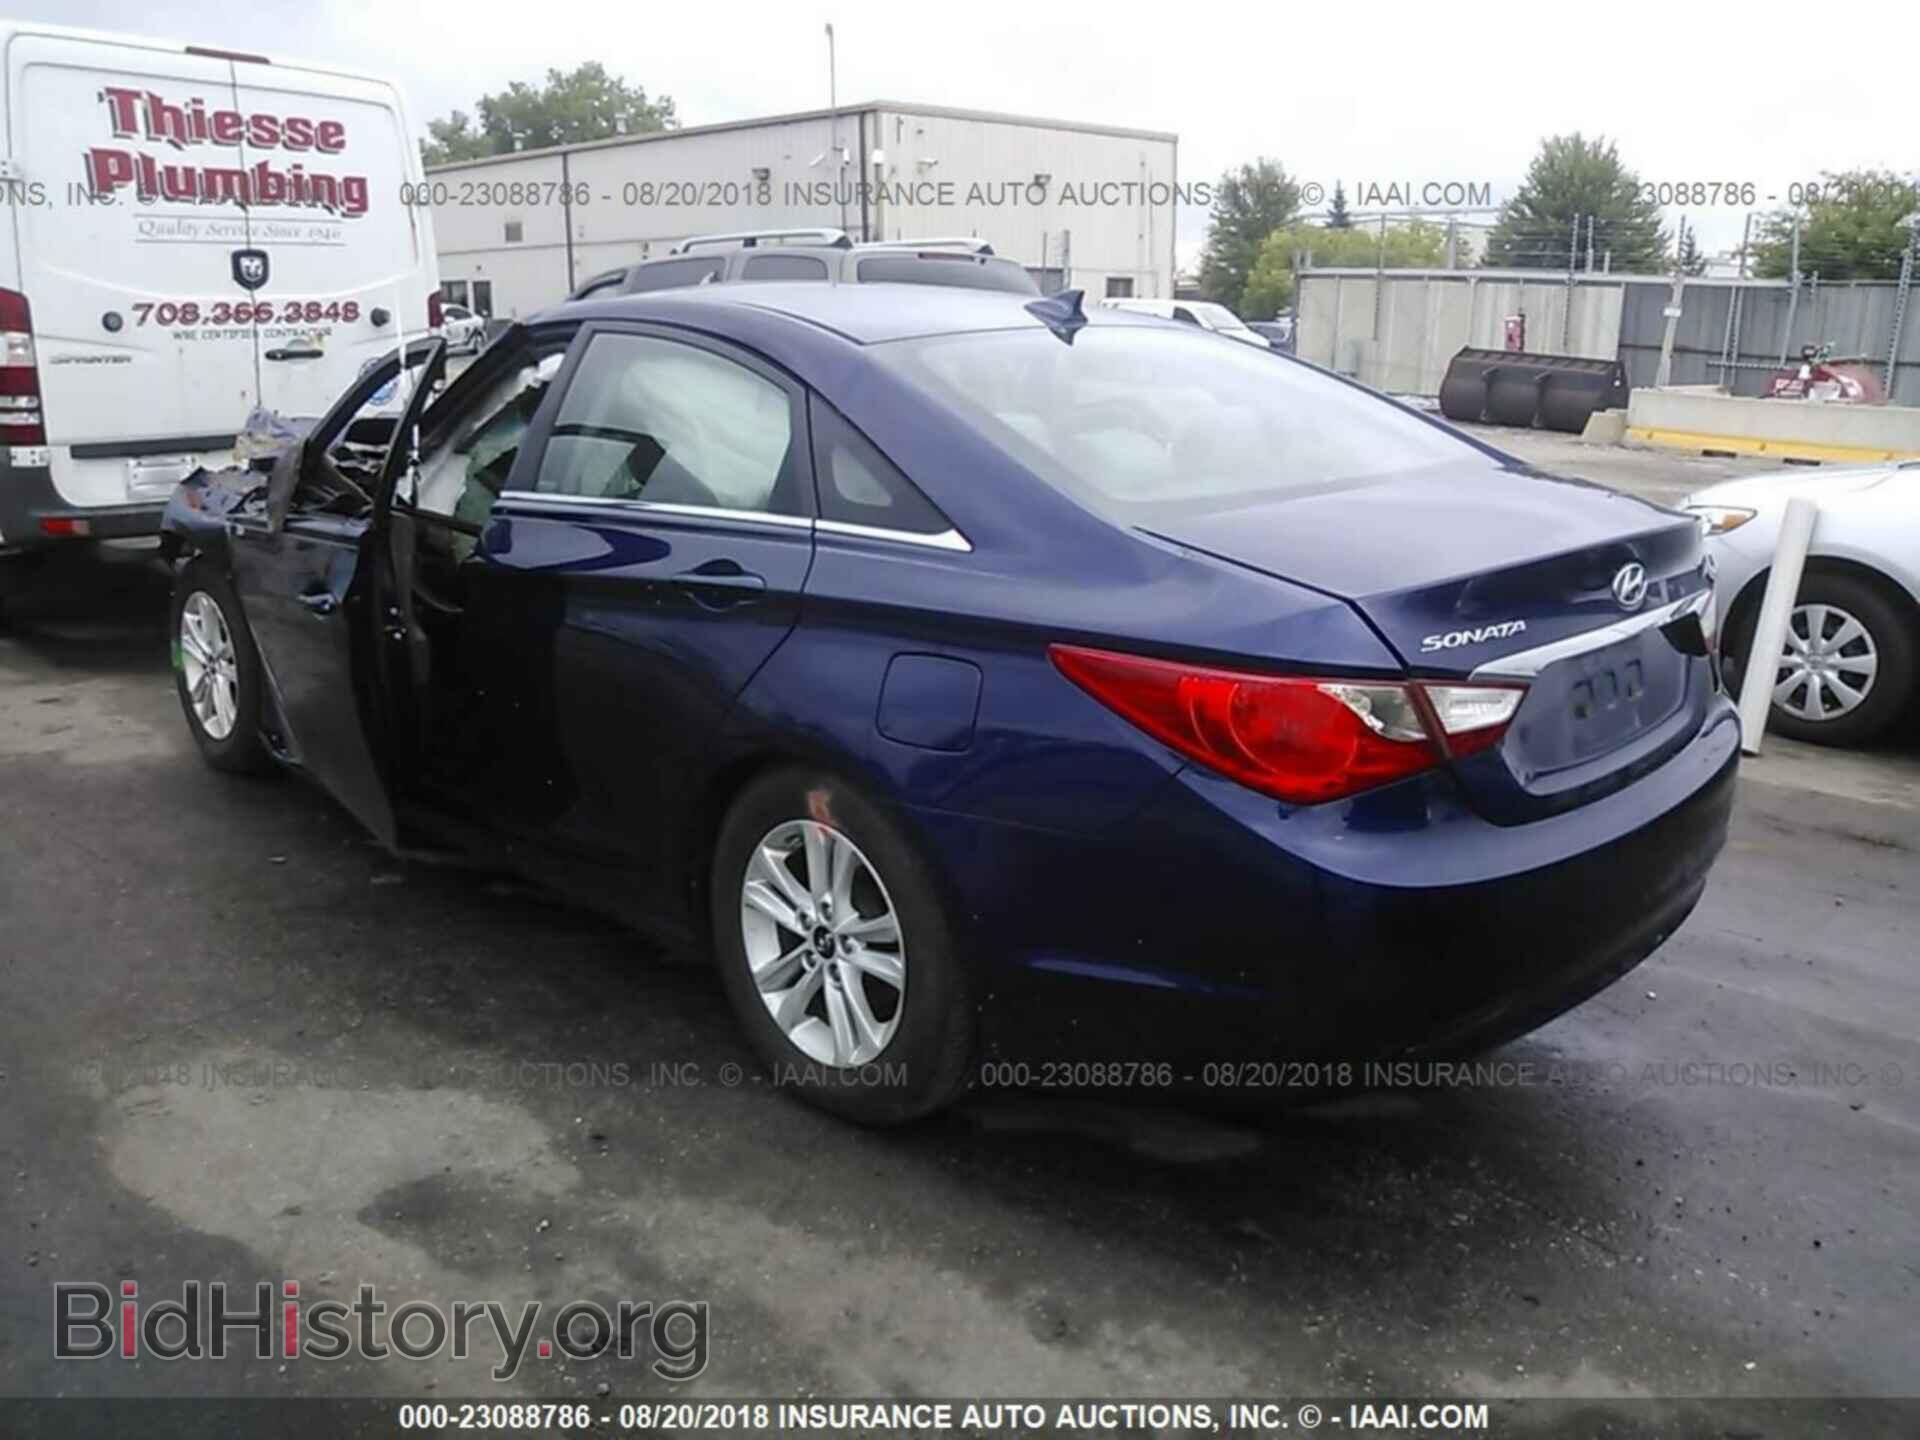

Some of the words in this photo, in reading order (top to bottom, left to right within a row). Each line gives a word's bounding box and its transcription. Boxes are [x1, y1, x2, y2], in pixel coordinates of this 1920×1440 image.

[97, 86, 347, 153] Thiesse
[83, 147, 369, 218] Plumbing
[138, 219, 200, 241] Quality
[132, 301, 360, 327] 708.366.3848
[1420, 620, 1527, 652] SONATA
